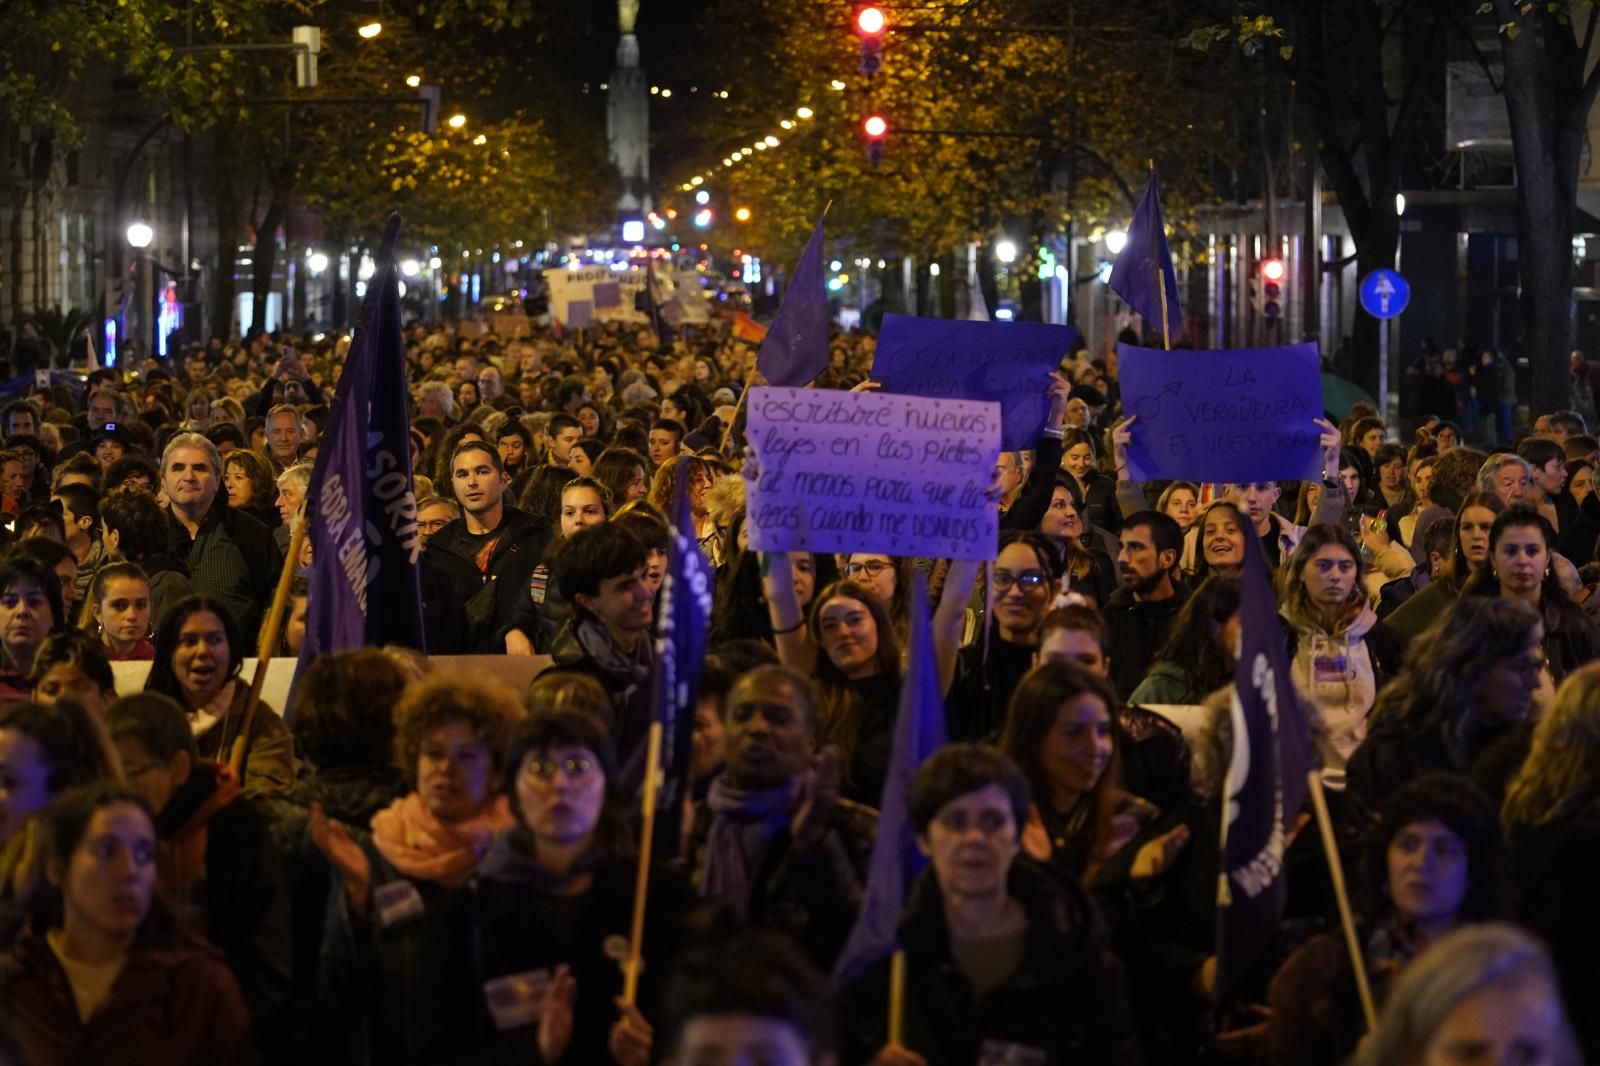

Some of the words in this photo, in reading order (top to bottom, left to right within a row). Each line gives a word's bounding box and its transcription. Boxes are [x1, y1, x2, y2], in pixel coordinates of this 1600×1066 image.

[1225, 365, 1257, 388] LA
[905, 407, 988, 434] nuevas
[1184, 395, 1308, 424] VERGÜENZA
[762, 426, 816, 466] leyes
[831, 436, 860, 456] en
[877, 432, 913, 461] las
[920, 437, 982, 466] pieles
[1169, 432, 1193, 456] ES
[1203, 429, 1310, 455] VUESTRA
[758, 467, 784, 494] al
[792, 470, 856, 498] menos
[922, 480, 957, 507] que
[320, 472, 353, 546] GORA
[880, 511, 908, 537] me
